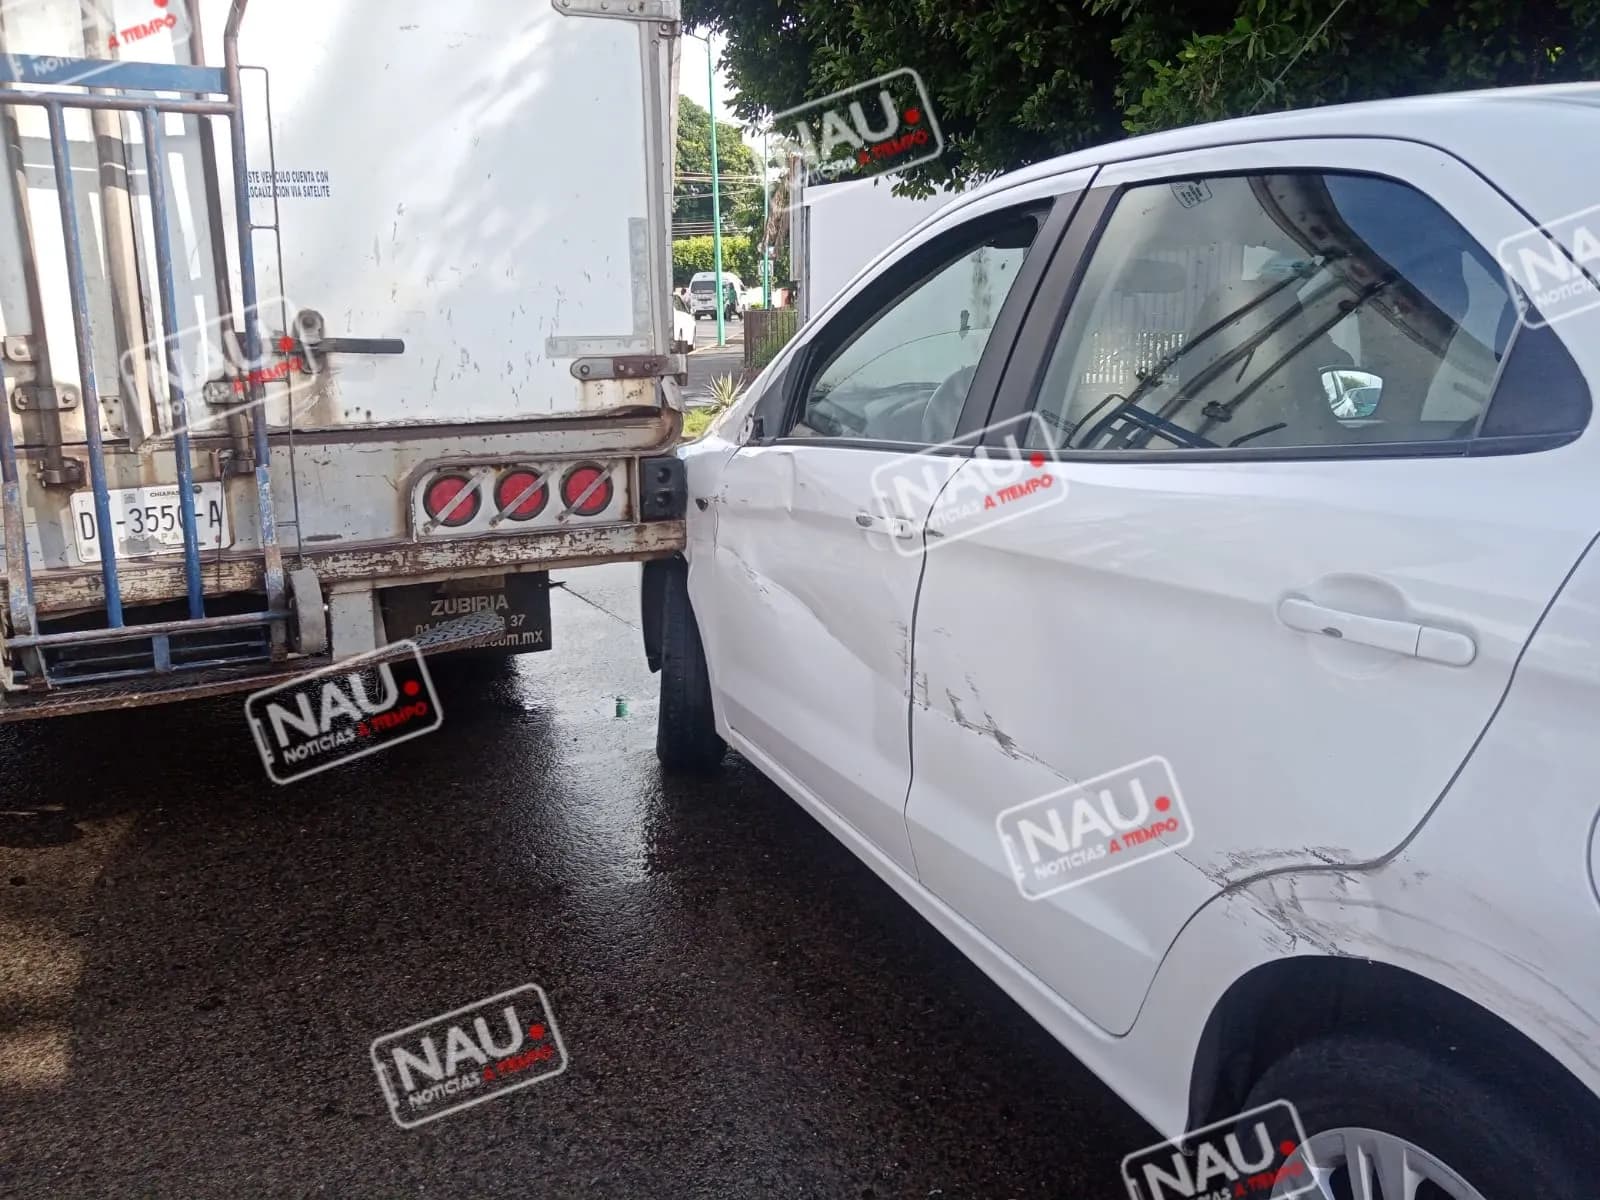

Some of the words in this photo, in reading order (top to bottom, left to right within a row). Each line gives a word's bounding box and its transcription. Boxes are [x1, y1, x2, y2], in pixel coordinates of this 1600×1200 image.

[248, 171, 259, 183] STE
[261, 171, 290, 183] VEHCULO
[291, 171, 315, 183] CUENTA
[316, 171, 329, 183] CON
[248, 185, 290, 198] OCALIZCION
[291, 185, 302, 198] VIA
[303, 185, 330, 198] SATELITE
[431, 595, 509, 616] ZUBIRIA
[510, 614, 526, 627] 37
